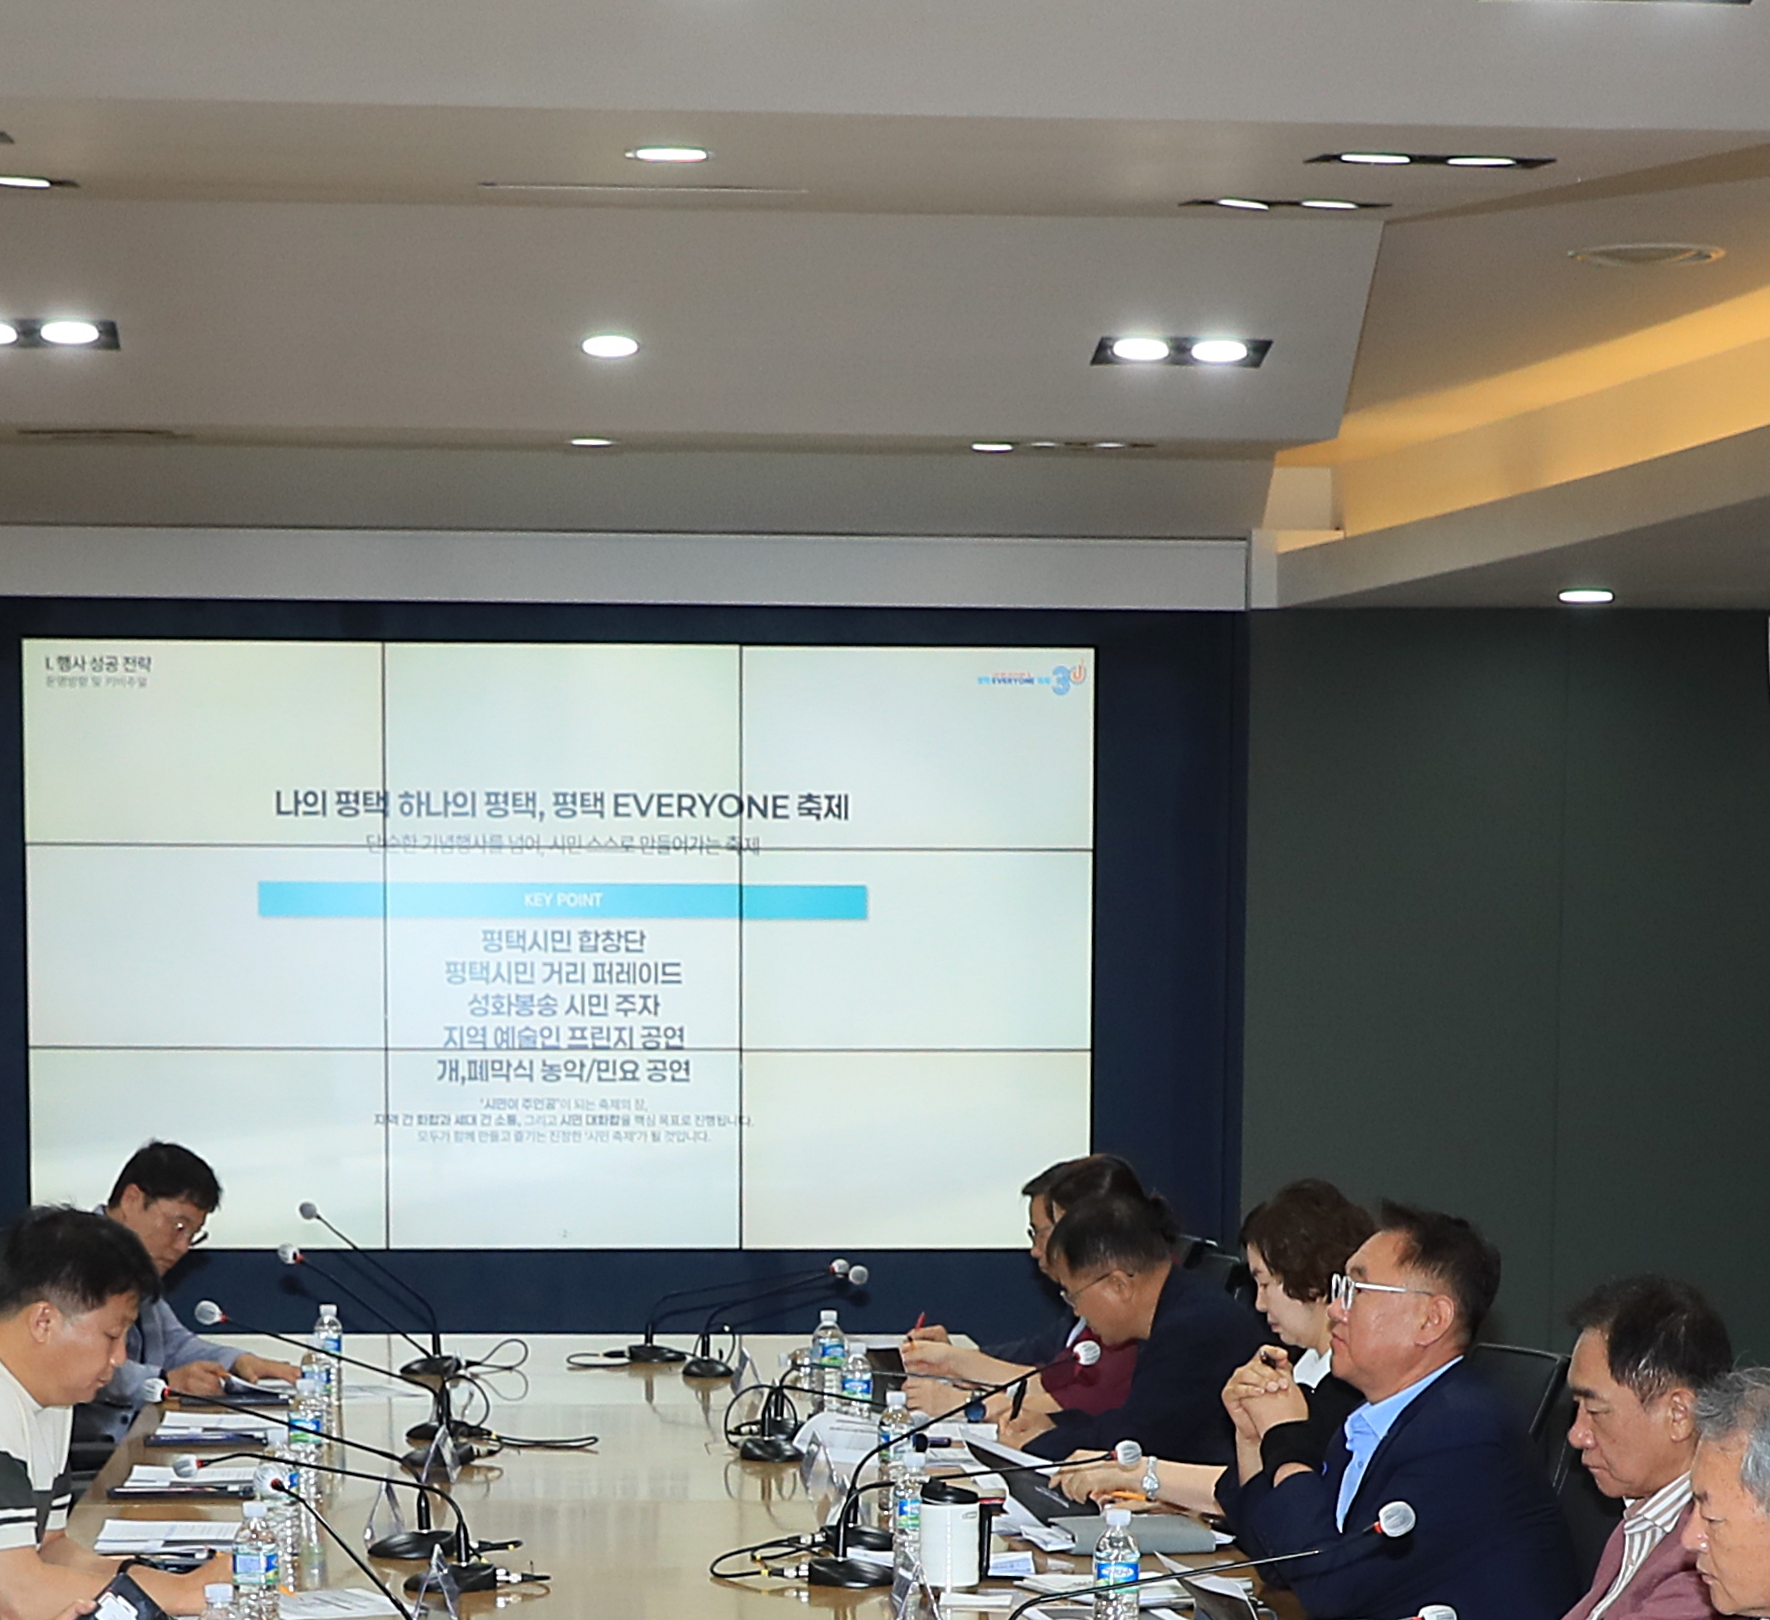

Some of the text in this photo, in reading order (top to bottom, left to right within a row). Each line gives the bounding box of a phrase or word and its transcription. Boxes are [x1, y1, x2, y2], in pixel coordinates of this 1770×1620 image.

[57, 655, 86, 673] 행사
[90, 655, 119, 673] 성공
[123, 655, 152, 673] 전략
[275, 790, 849, 822] 나의 평택 하나의 평택, 평택 EVERYONE 축제
[366, 834, 418, 855] 단순한
[422, 834, 504, 855] 기념행사를
[550, 835, 582, 856] 시민
[588, 836, 634, 855] 스스로
[640, 835, 721, 856] 만들어가는
[524, 892, 603, 908] KEY POINT
[481, 929, 646, 953] 평택시민 합창단
[444, 960, 683, 985] 평택시민 거리 퍼레이드
[468, 993, 661, 1018] 성화봉송 시민 주자
[443, 1025, 686, 1050] 지역 예술인 프린지 공연
[437, 1058, 691, 1085] 개,폐막식 농악/민요 공연
